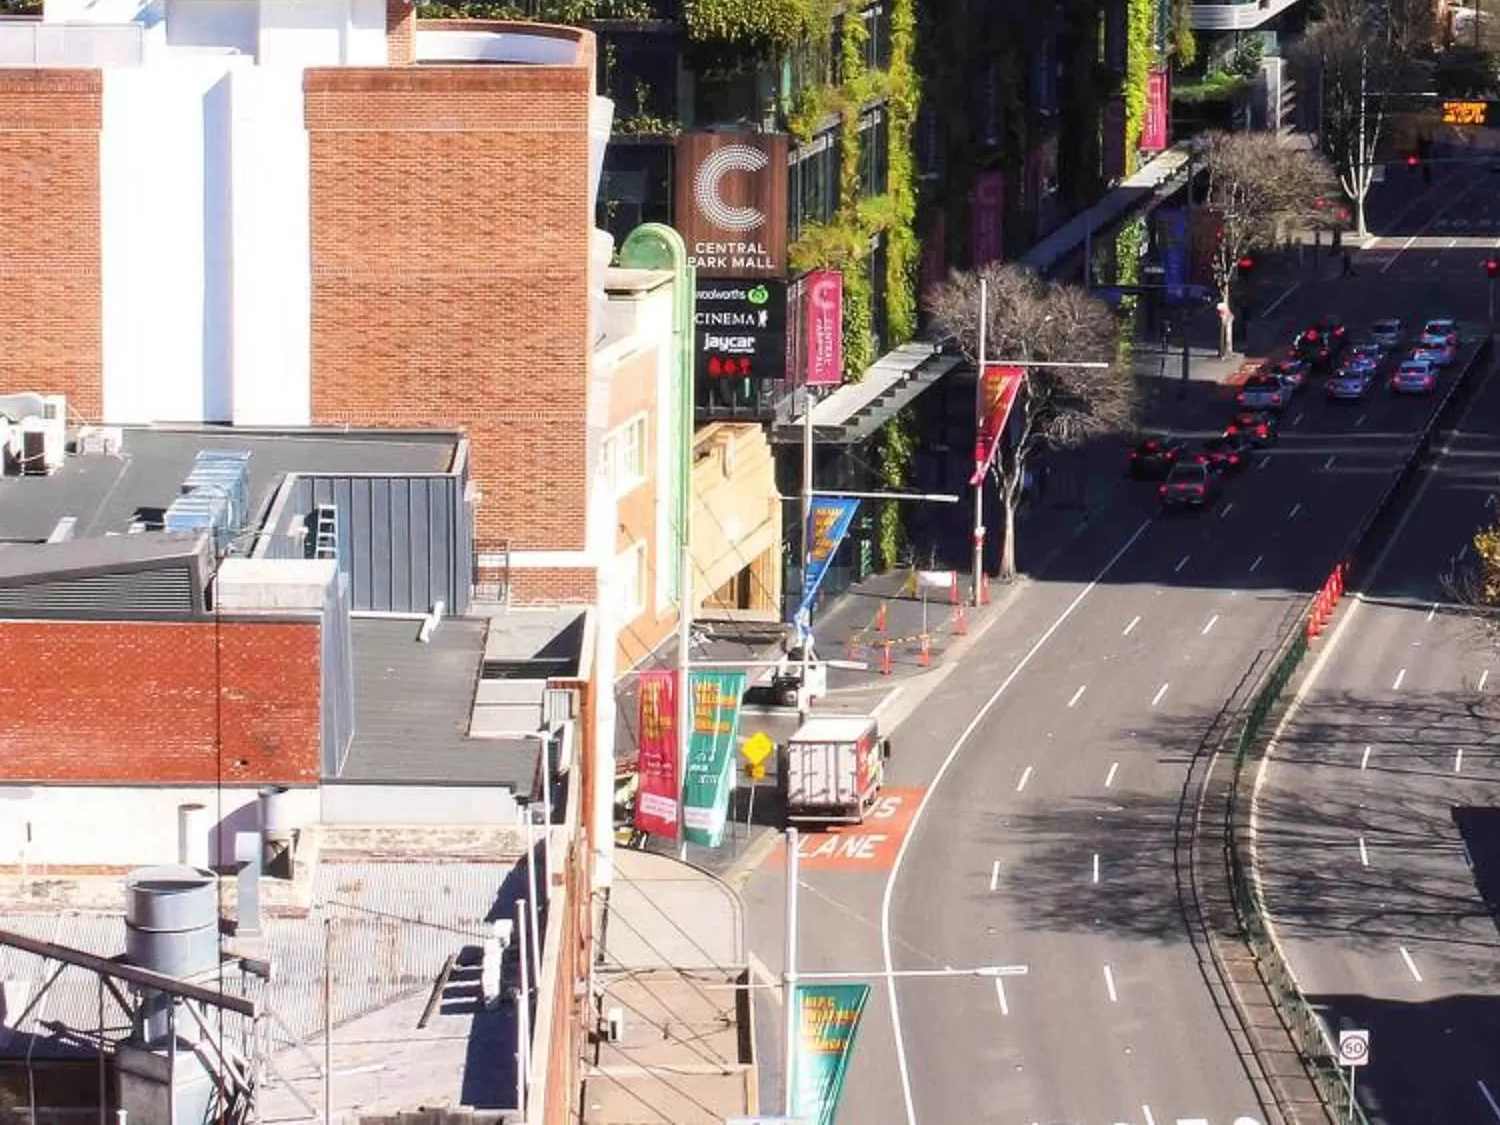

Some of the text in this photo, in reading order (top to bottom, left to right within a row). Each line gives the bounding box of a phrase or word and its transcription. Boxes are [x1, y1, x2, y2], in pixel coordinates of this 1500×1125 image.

[693, 143, 769, 232] C
[695, 242, 767, 254] CENTRAL
[687, 256, 776, 268] PARK MALL
[797, 834, 889, 859] LANE
[1345, 1042, 1362, 1054] 50
